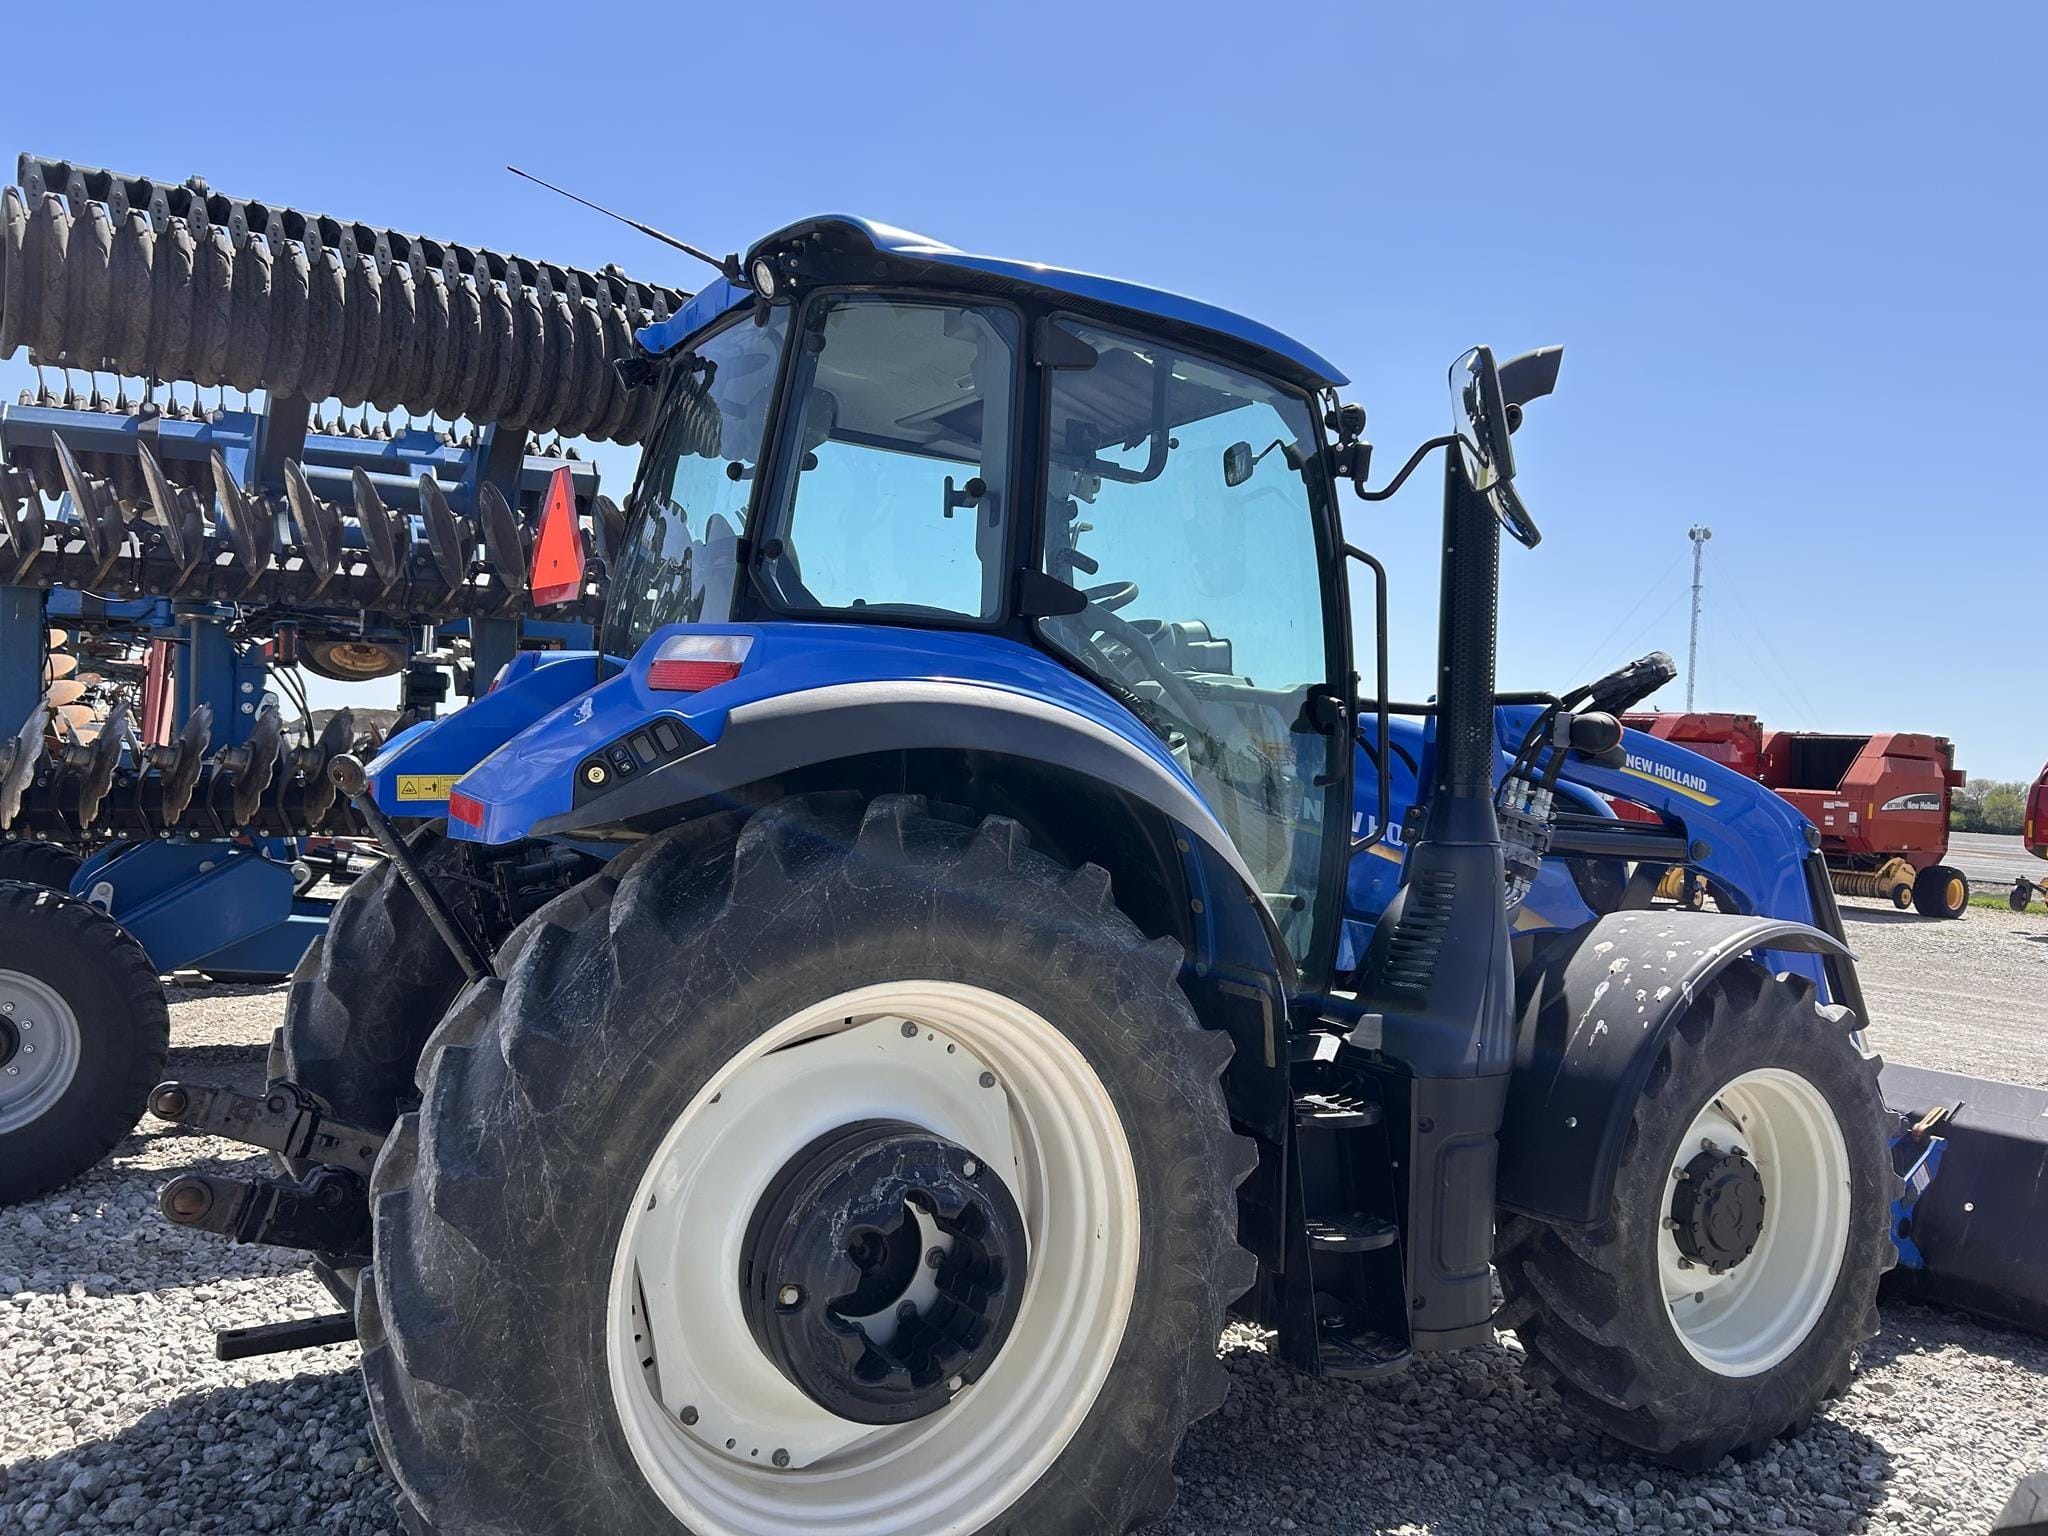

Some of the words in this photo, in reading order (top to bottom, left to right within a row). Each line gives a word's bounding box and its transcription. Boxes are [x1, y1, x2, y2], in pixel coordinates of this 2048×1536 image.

[1626, 753, 1653, 774] NEW
[1655, 763, 1707, 793] HOLLAND
[1907, 801, 1919, 810] New
[1920, 801, 1940, 811] Holland
